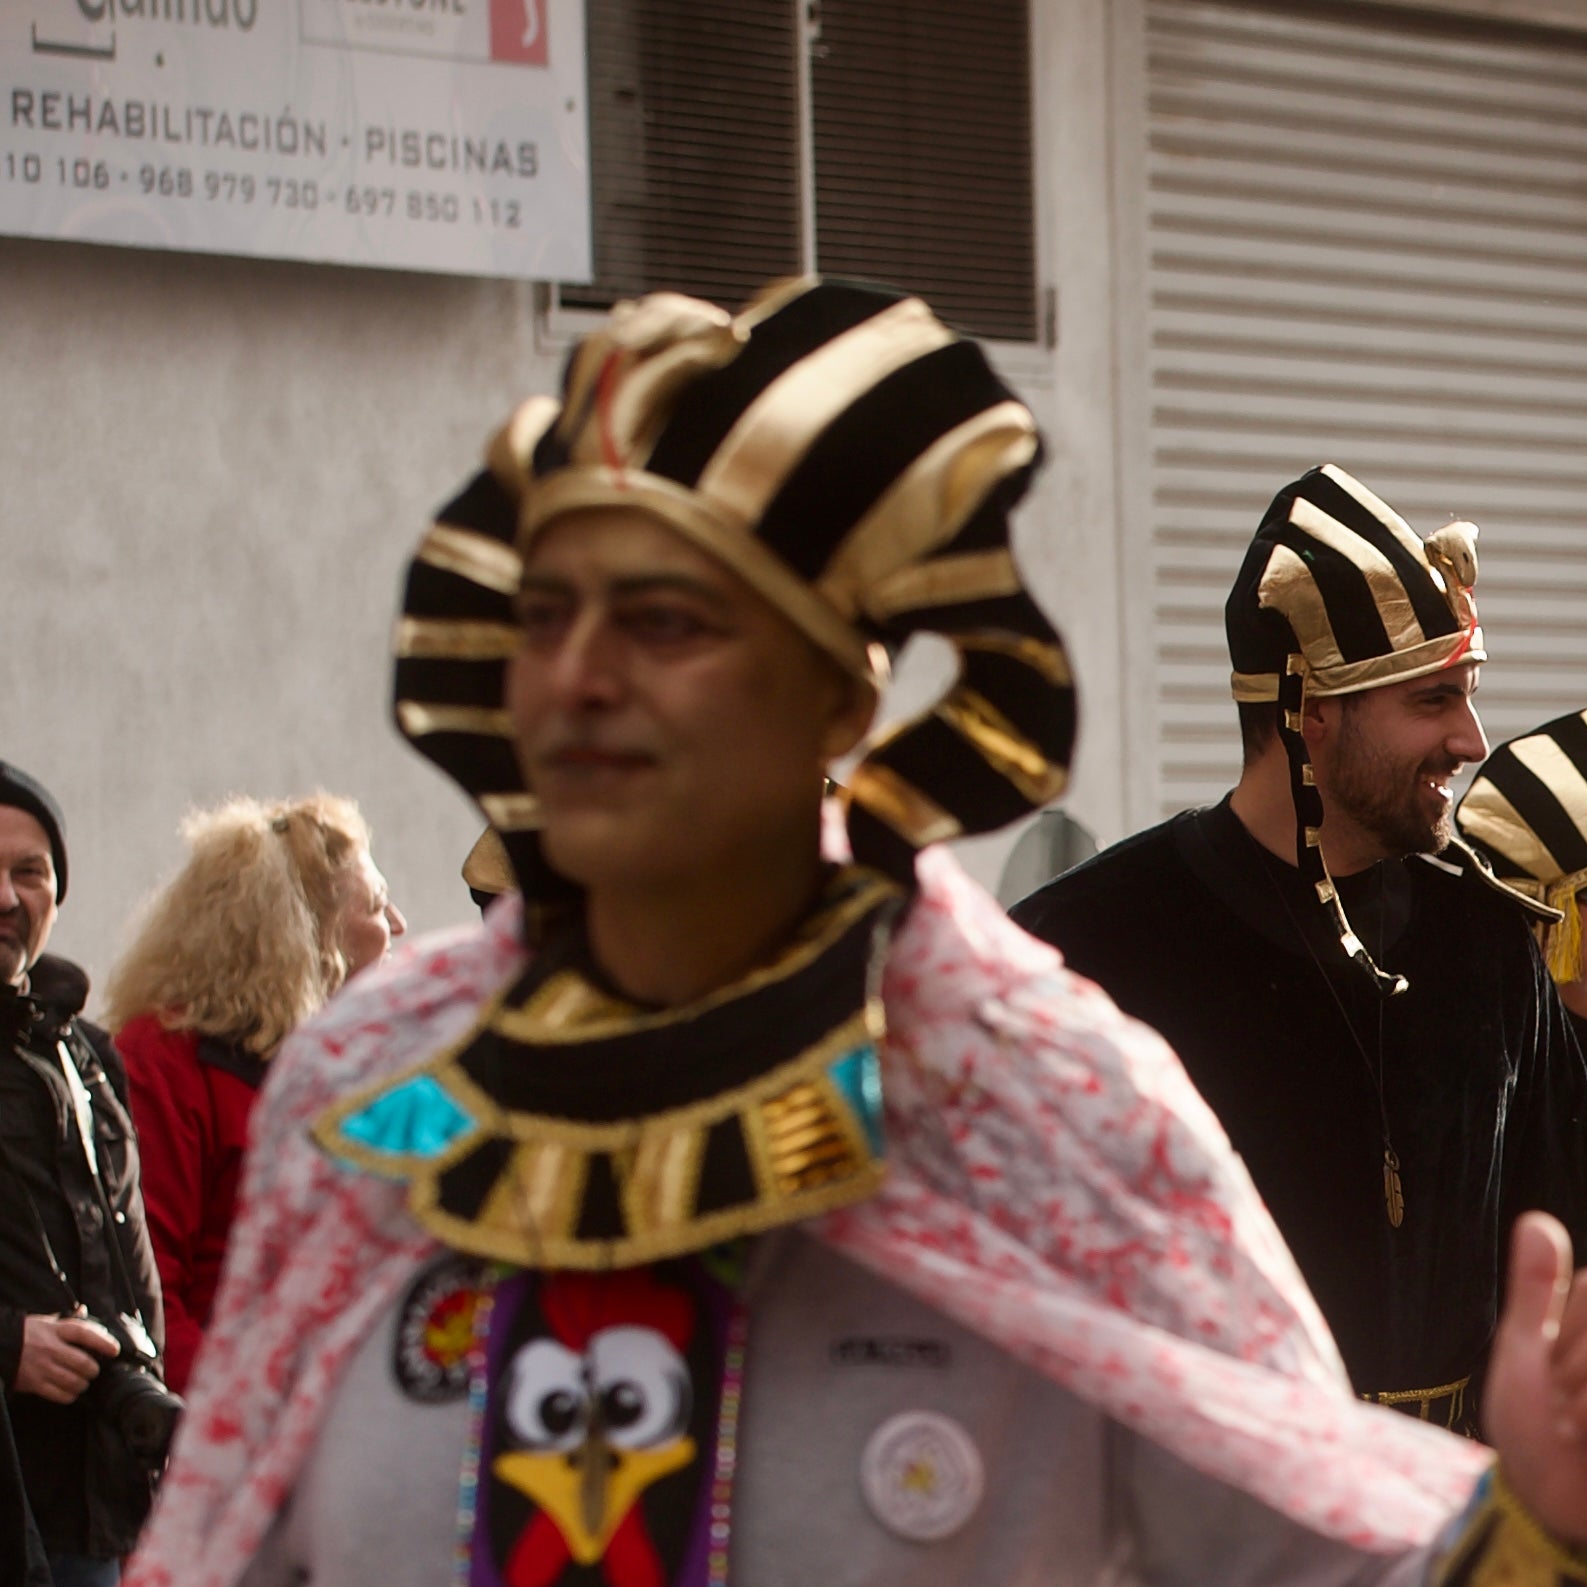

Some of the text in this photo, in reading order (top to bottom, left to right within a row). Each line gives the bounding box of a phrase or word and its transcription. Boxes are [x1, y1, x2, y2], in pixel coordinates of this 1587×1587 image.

[11, 87, 539, 178] REHABILITACIÓN PISCINAS
[57, 157, 110, 191] 106
[139, 164, 194, 198] 968
[204, 170, 256, 203] 979
[266, 176, 319, 211] 730
[345, 184, 396, 216] 697
[406, 191, 459, 223] 850
[473, 197, 521, 229] 112
